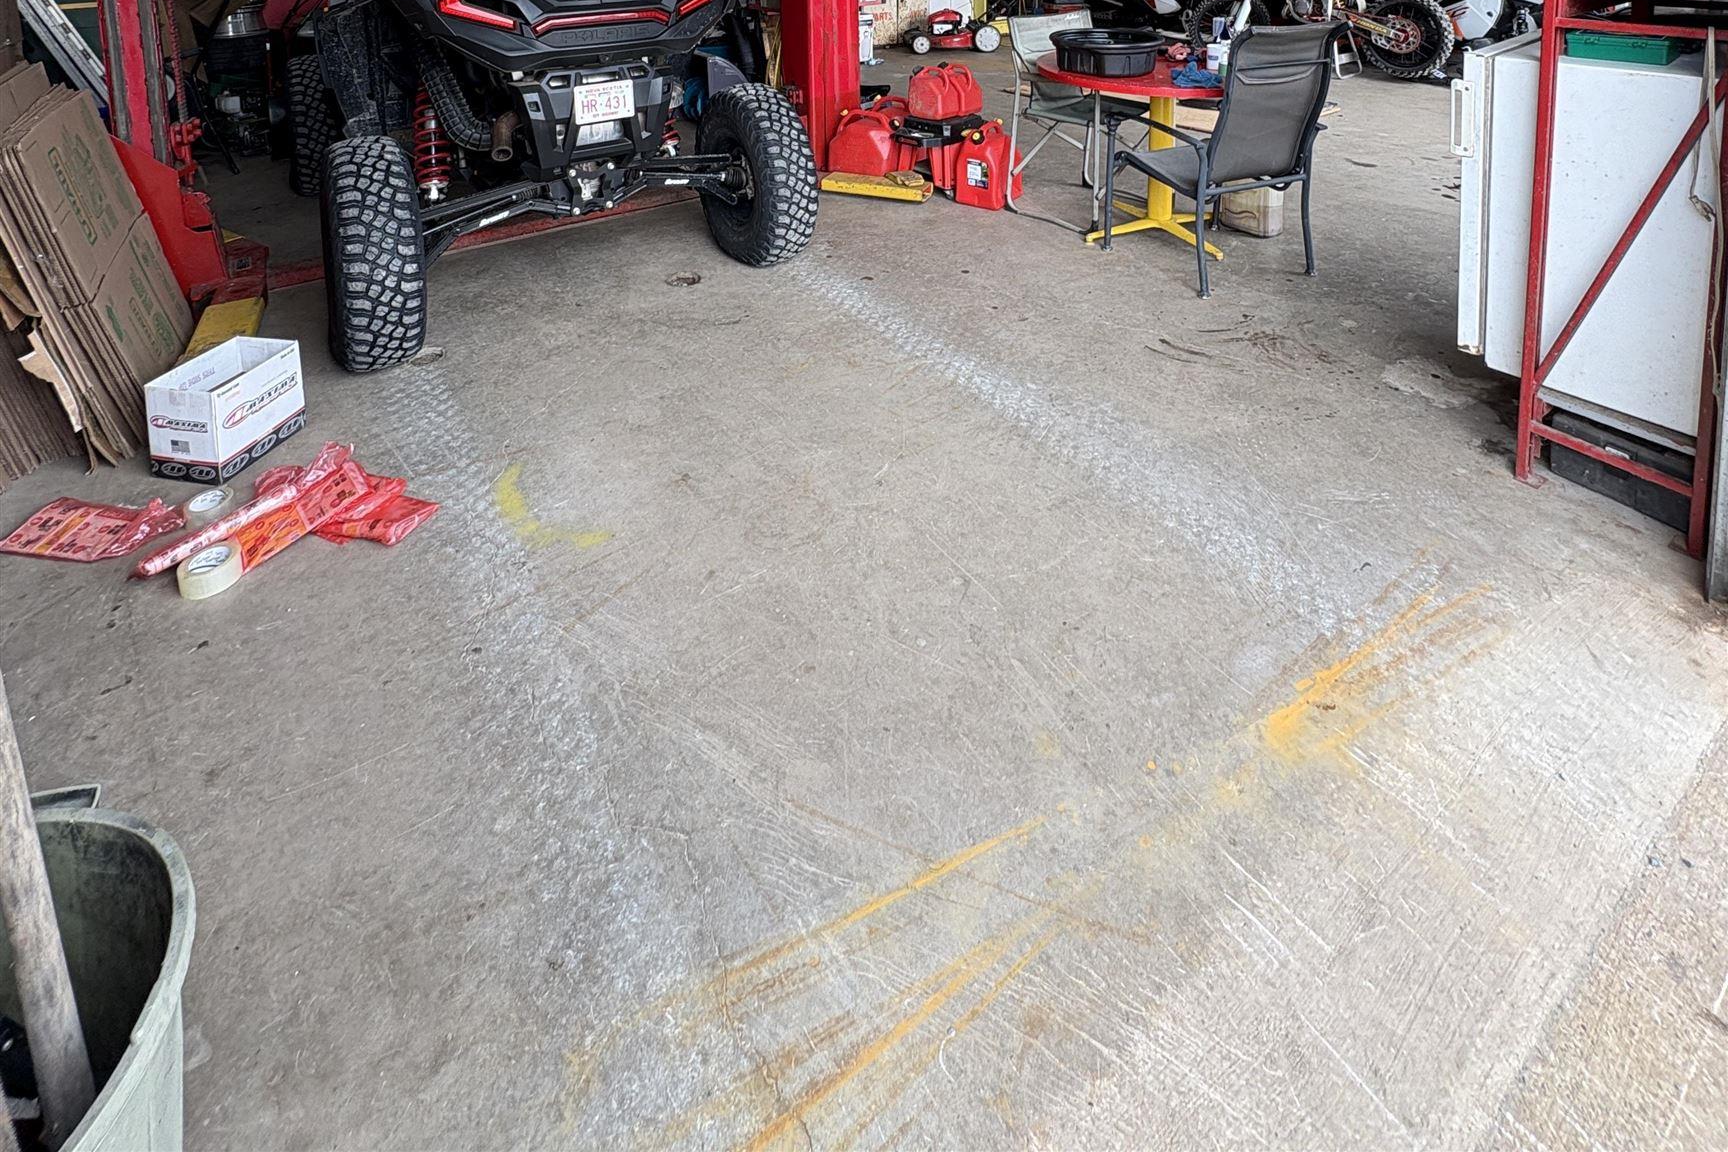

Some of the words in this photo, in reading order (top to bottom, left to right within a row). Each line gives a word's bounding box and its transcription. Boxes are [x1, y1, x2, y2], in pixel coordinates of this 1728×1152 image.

[561, 26, 650, 43] POLARIS
[1358, 20, 1388, 34] HONDA
[581, 98, 598, 115] HR
[604, 95, 628, 110] 431
